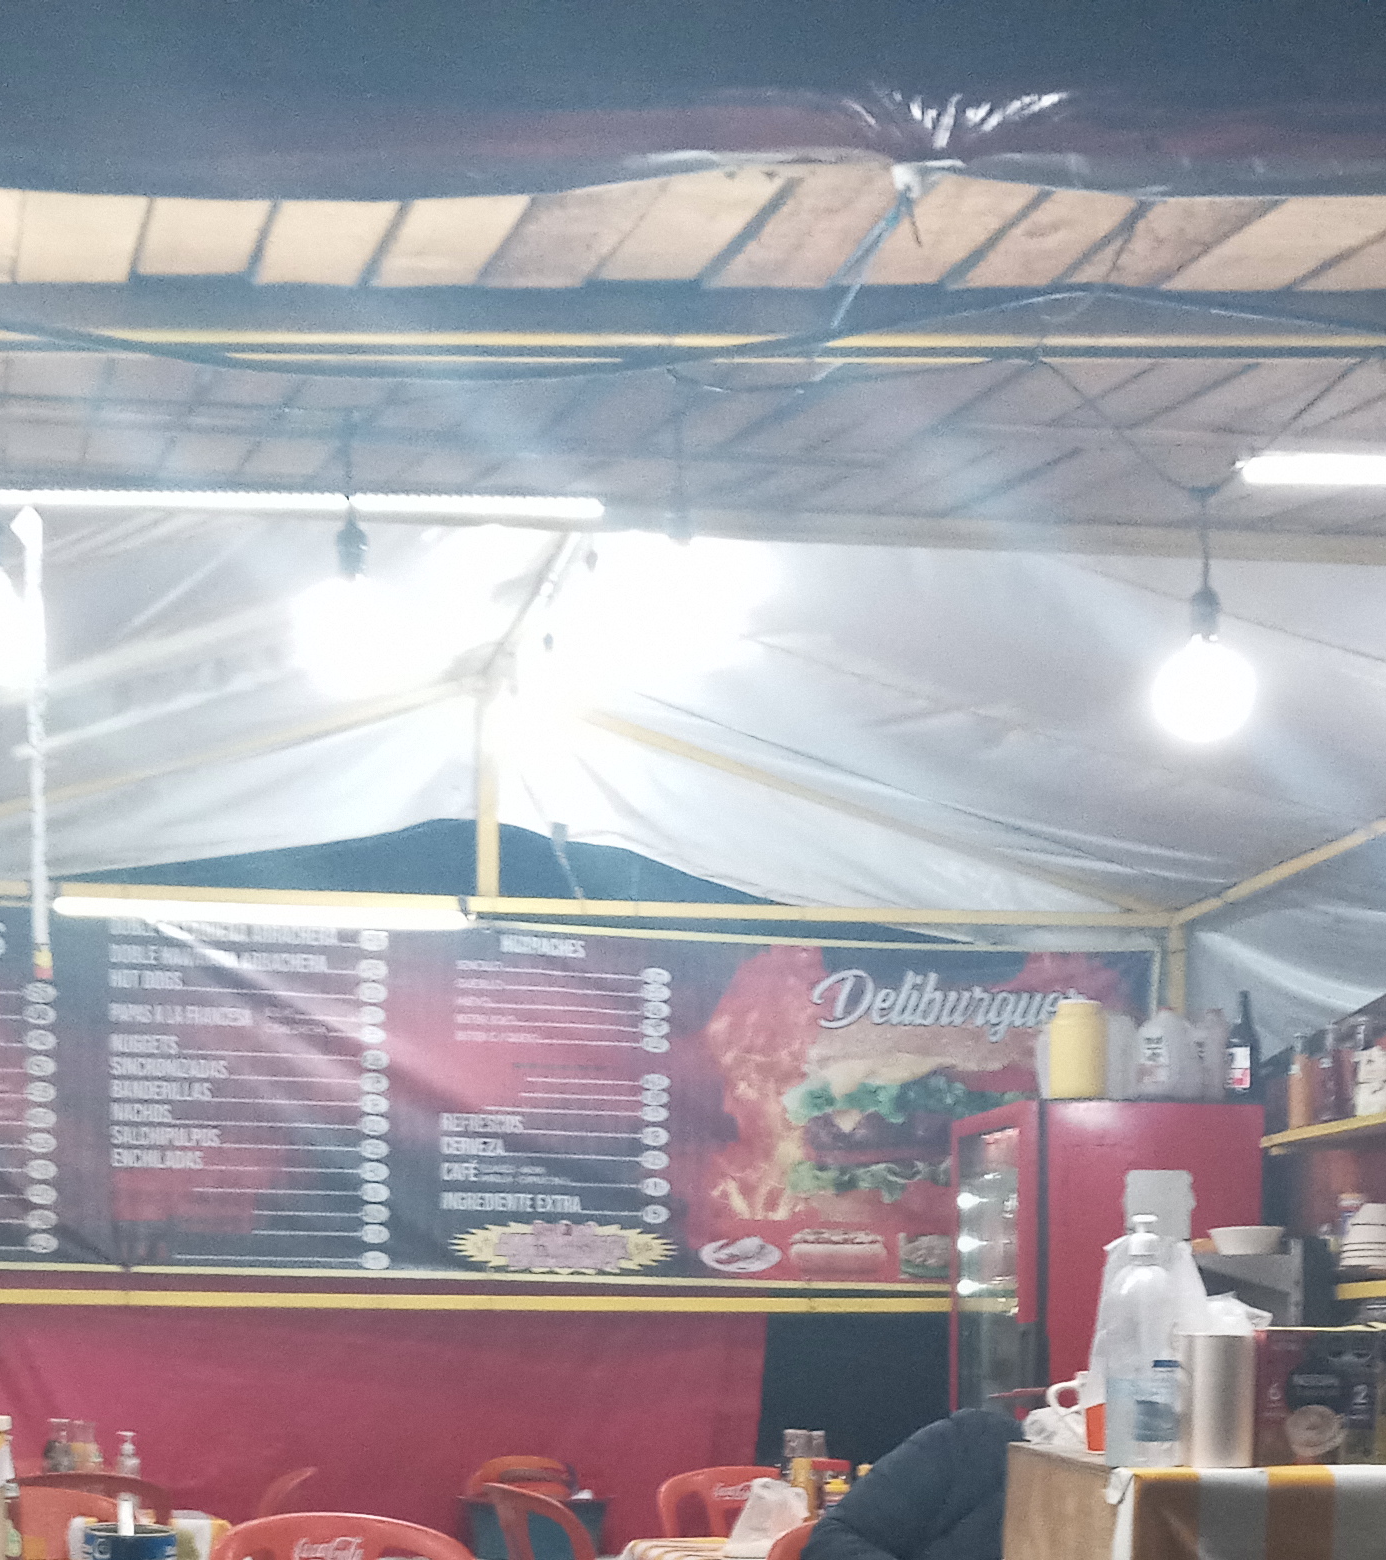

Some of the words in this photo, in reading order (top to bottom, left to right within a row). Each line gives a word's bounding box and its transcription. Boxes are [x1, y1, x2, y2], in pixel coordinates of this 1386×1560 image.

[109, 969, 140, 989] HOT
[141, 970, 184, 990] DOGS
[812, 968, 1088, 1042] Deliburgue
[109, 1033, 179, 1055] NUGGETS
[110, 1079, 213, 1099] BANDERILLAS
[110, 1102, 172, 1122] NACHOS
[440, 1113, 524, 1134] REFRESCOS
[440, 1137, 505, 1156] CERVEZA
[440, 1160, 479, 1181] CAFÉ
[440, 1191, 535, 1212] INGREDIENTE
[537, 1194, 581, 1213] EXTRA
